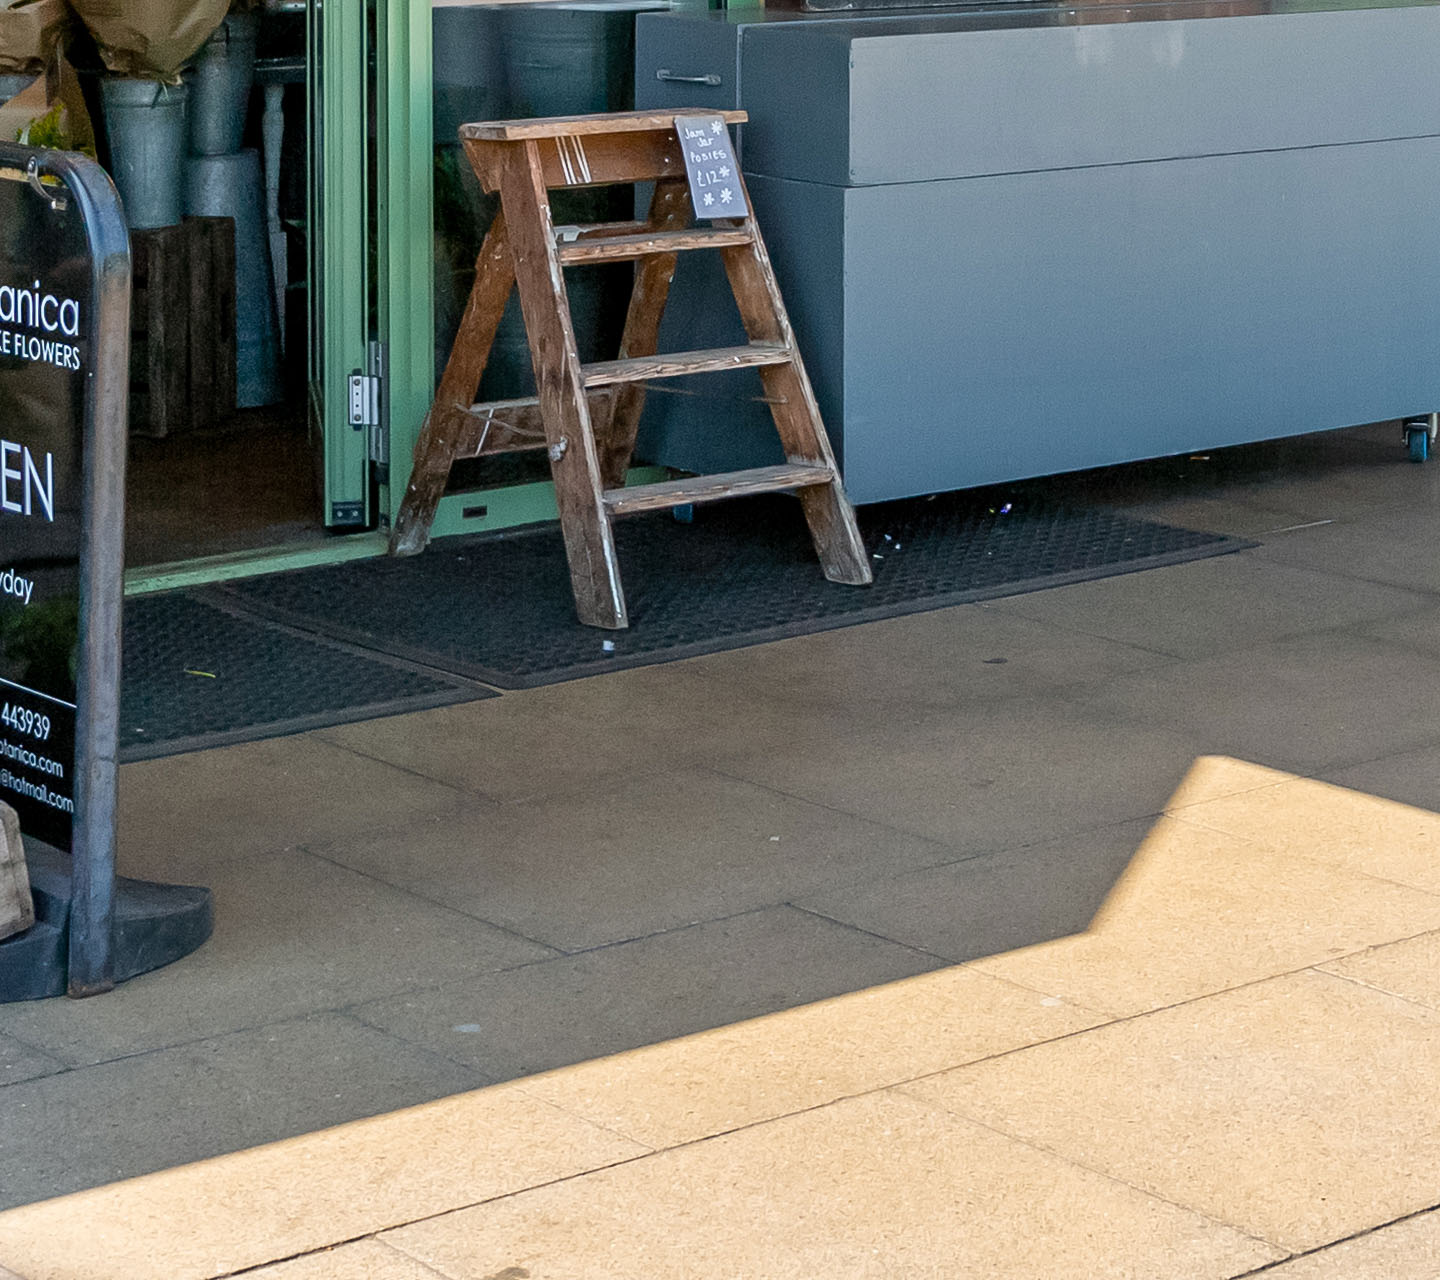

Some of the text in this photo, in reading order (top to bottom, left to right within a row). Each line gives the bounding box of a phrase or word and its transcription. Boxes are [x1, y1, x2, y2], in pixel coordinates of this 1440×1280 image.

[685, 127, 705, 140] Jam
[697, 171, 722, 187] £12
[14, 333, 80, 370] FLOWERS
[1, 702, 51, 740] 443939
